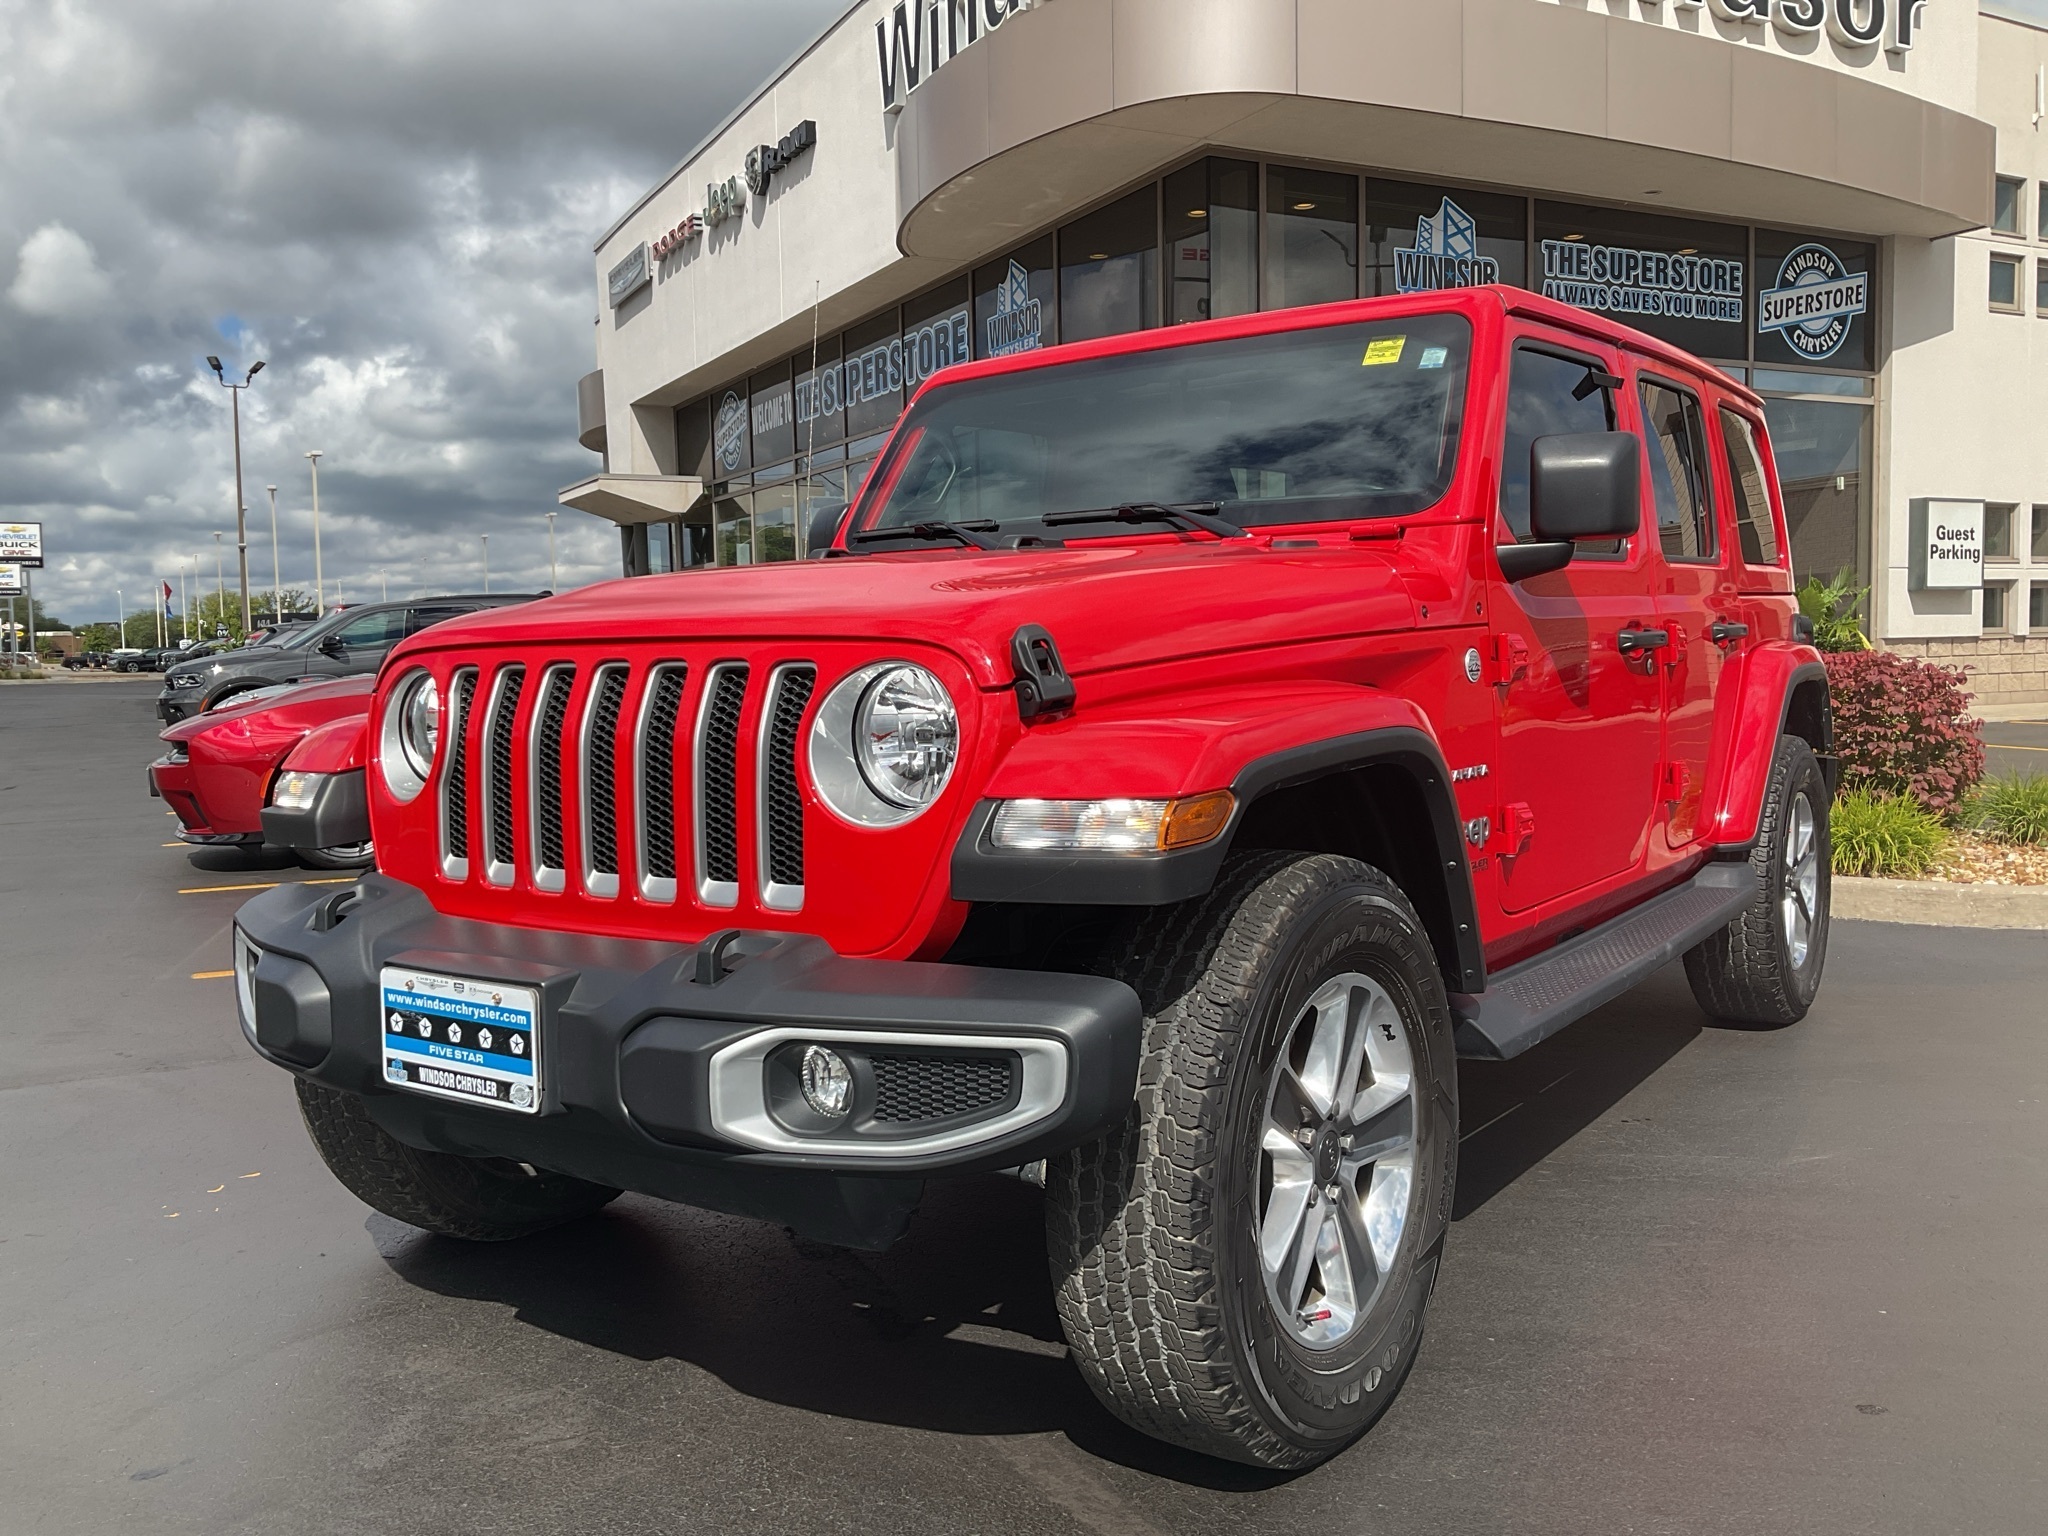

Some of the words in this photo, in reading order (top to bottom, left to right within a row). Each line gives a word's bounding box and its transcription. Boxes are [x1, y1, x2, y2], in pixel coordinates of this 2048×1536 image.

[764, 119, 816, 174] RAM
[703, 174, 746, 227] Jeep
[652, 213, 703, 262] DODGE
[1397, 252, 1496, 290] WINDSOR
[1543, 240, 1590, 279] THE
[1591, 246, 1742, 295] SUPERSTORE
[1785, 252, 1835, 282] WINDSOR
[1544, 281, 1608, 308] ALWAYS
[1611, 287, 1660, 313] SAVES
[1664, 292, 1693, 316] YOU
[1695, 297, 1741, 321] MORE!
[1764, 284, 1863, 322] SUPERSTORE
[988, 303, 1040, 349] WINDSOR
[1793, 320, 1843, 353] CHRYSLER
[752, 396, 782, 436] WELCOME
[783, 391, 792, 423] TO
[797, 376, 820, 423] THE
[822, 310, 968, 416] SUPERSTORE
[716, 409, 746, 452] SUPERSTORE
[1936, 525, 1975, 541] Guest
[1930, 544, 1980, 563] Parking
[387, 993, 527, 1025] www.windsorchrysler.com
[428, 1044, 453, 1059] FIVE
[454, 1048, 484, 1064] STAR
[418, 1066, 455, 1089] WINDSOR
[456, 1074, 497, 1097] CHRYSLER
